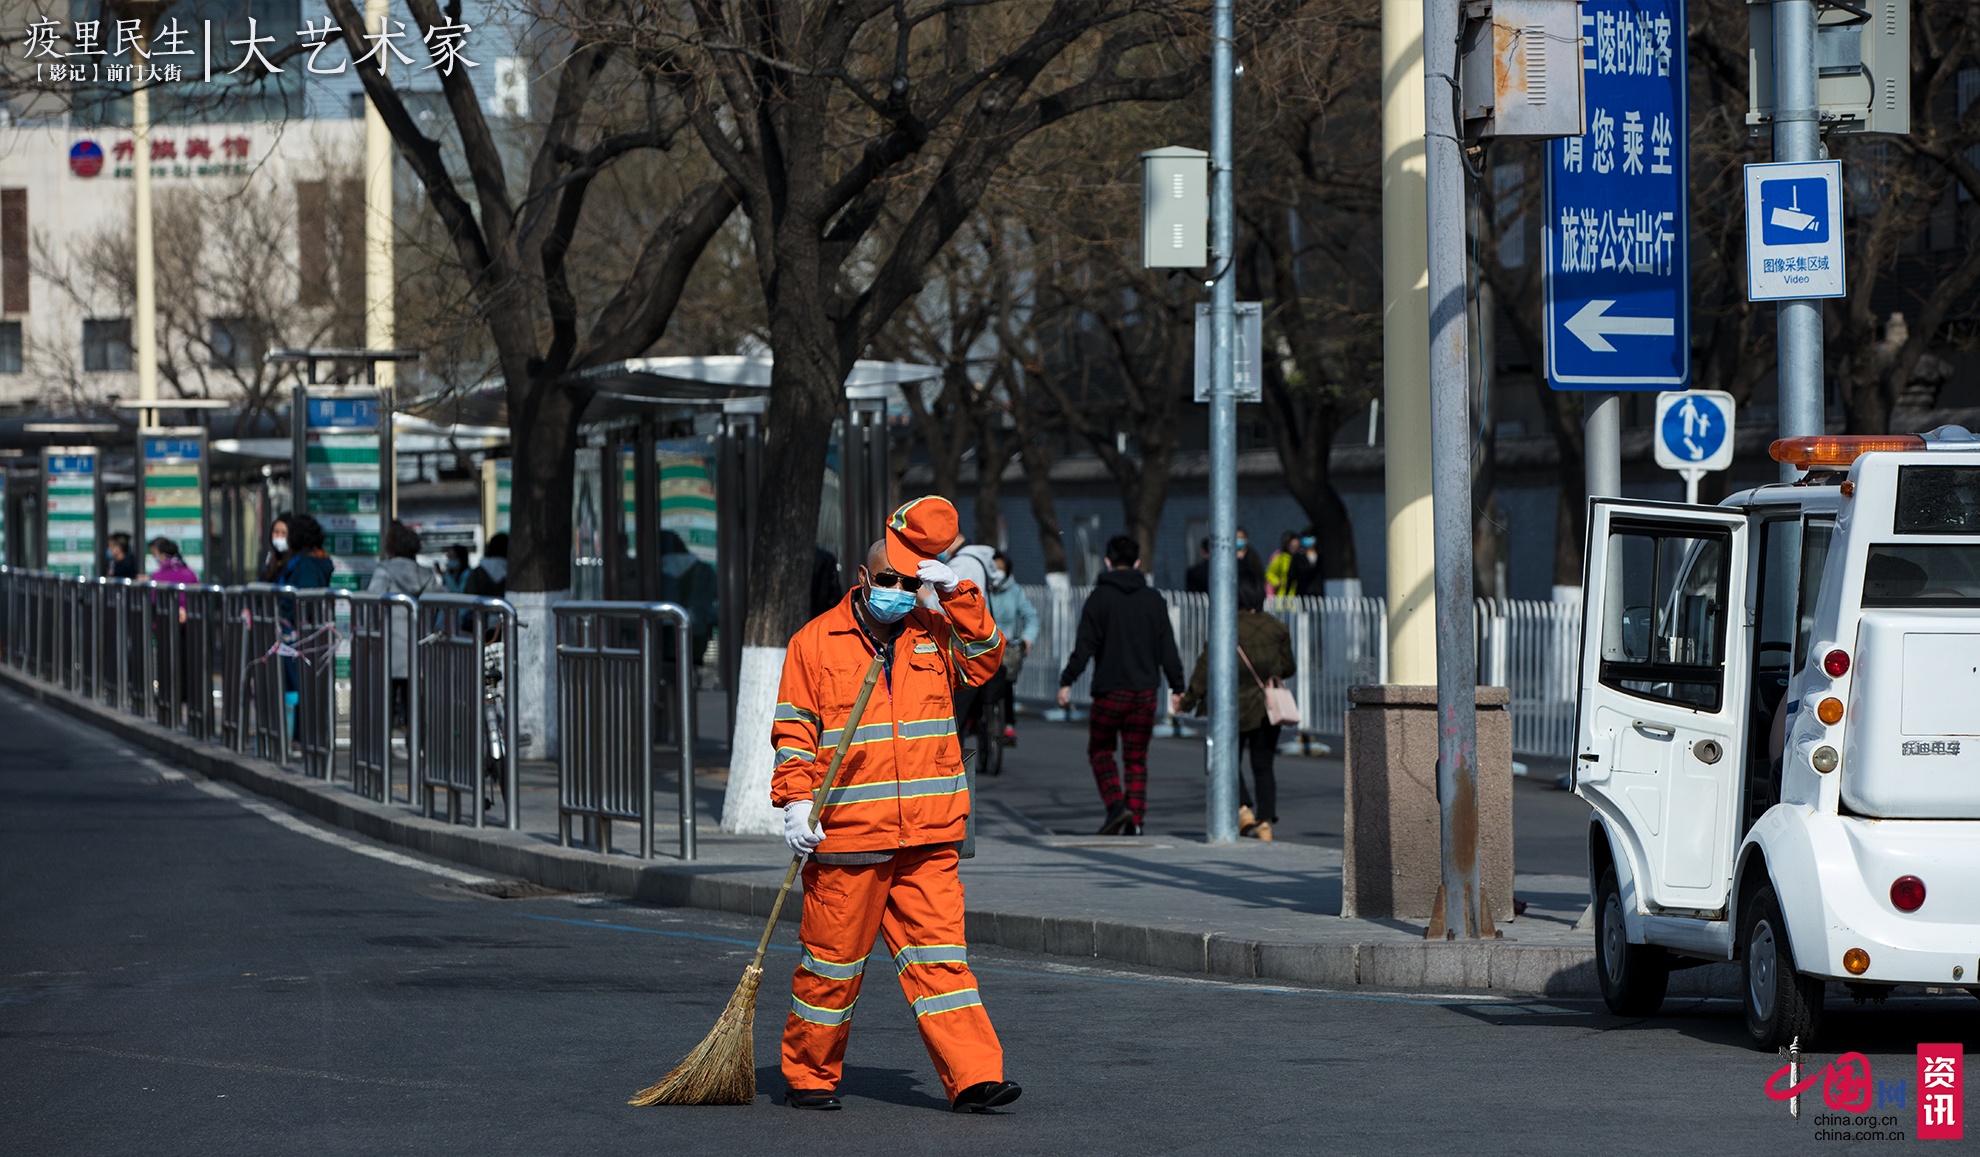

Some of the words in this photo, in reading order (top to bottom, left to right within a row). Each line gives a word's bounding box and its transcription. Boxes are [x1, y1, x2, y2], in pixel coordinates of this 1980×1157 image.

[1561, 206, 1675, 276] 旅游公交出行
[1763, 256, 1829, 273] 图像采集区域
[1783, 275, 1810, 284] Video
